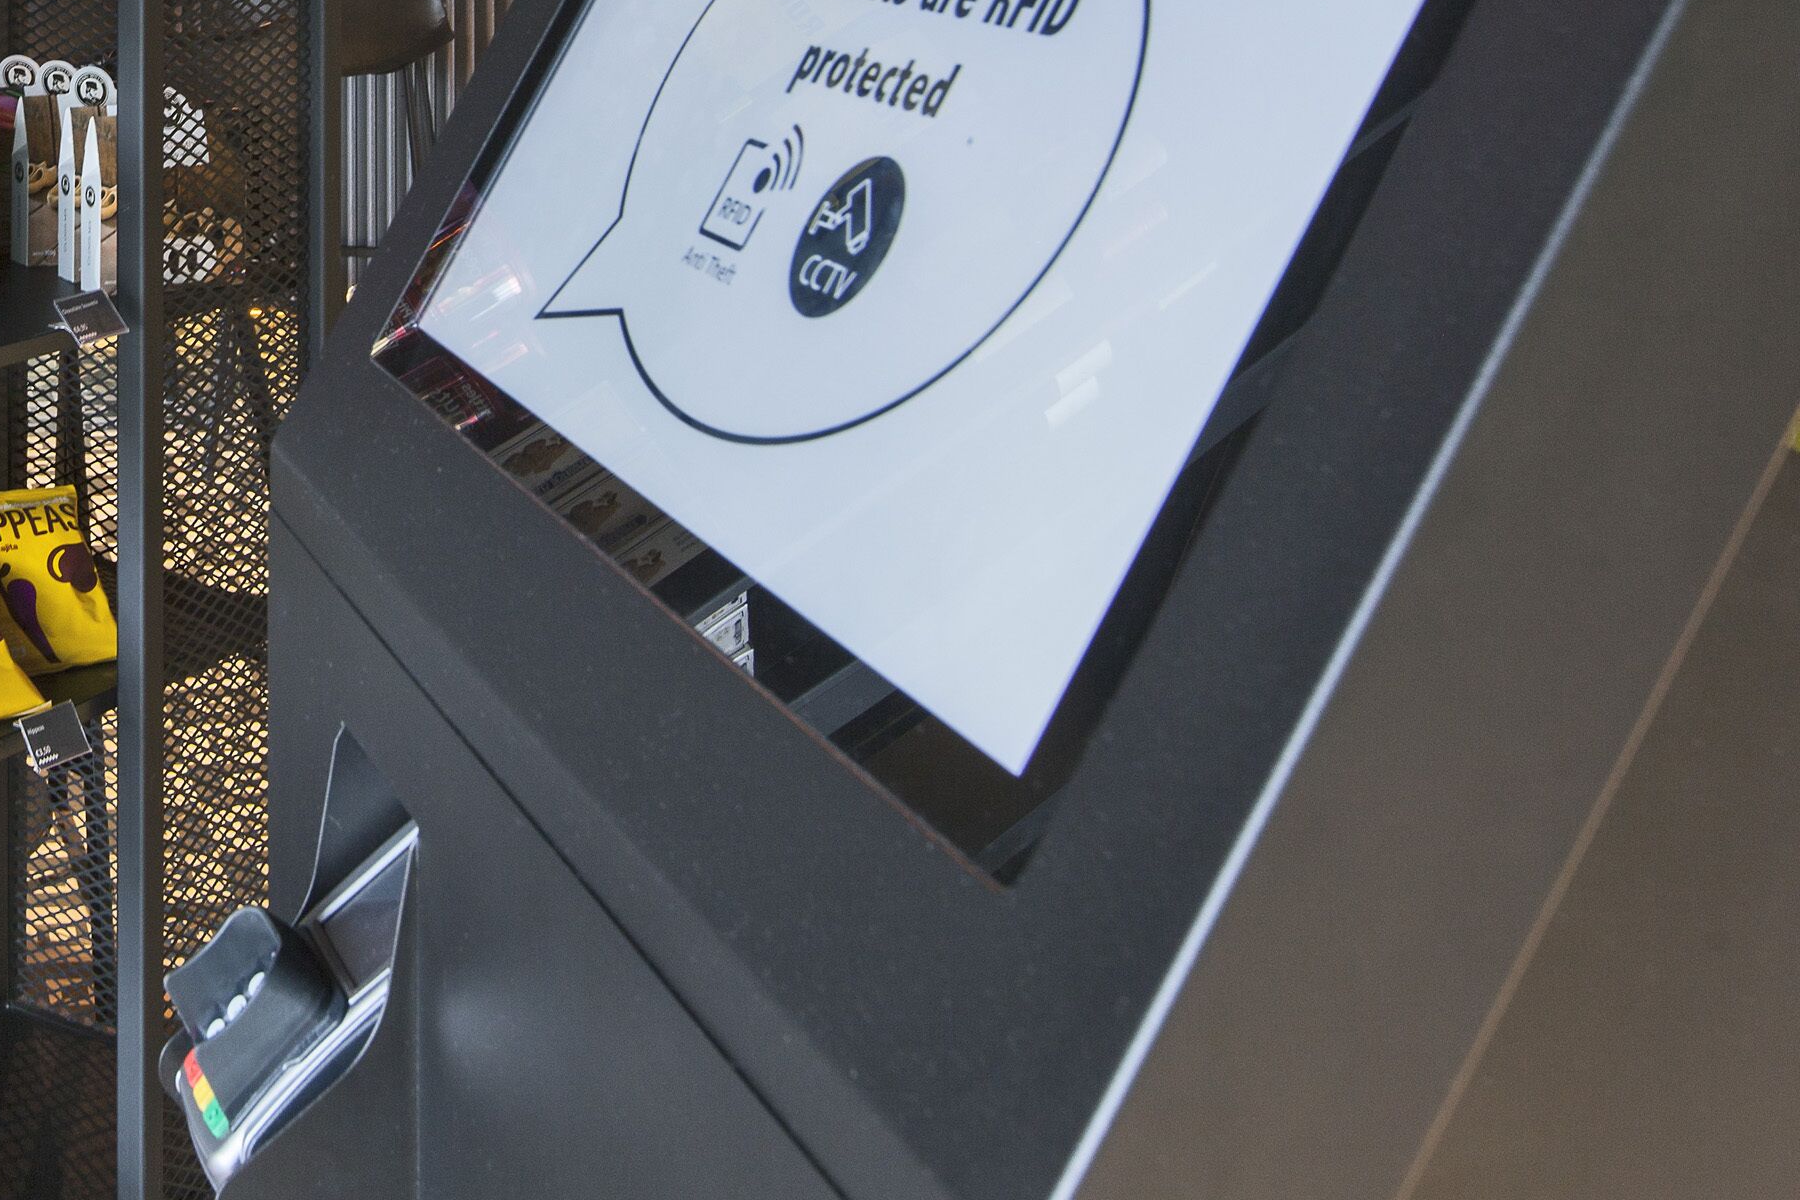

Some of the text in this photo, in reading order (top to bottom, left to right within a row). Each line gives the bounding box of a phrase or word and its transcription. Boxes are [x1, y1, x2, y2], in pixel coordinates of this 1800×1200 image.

[786, 46, 962, 118] protected
[717, 197, 752, 226] RFID
[681, 246, 738, 286] Anti Theft
[800, 254, 858, 300] CCTV
